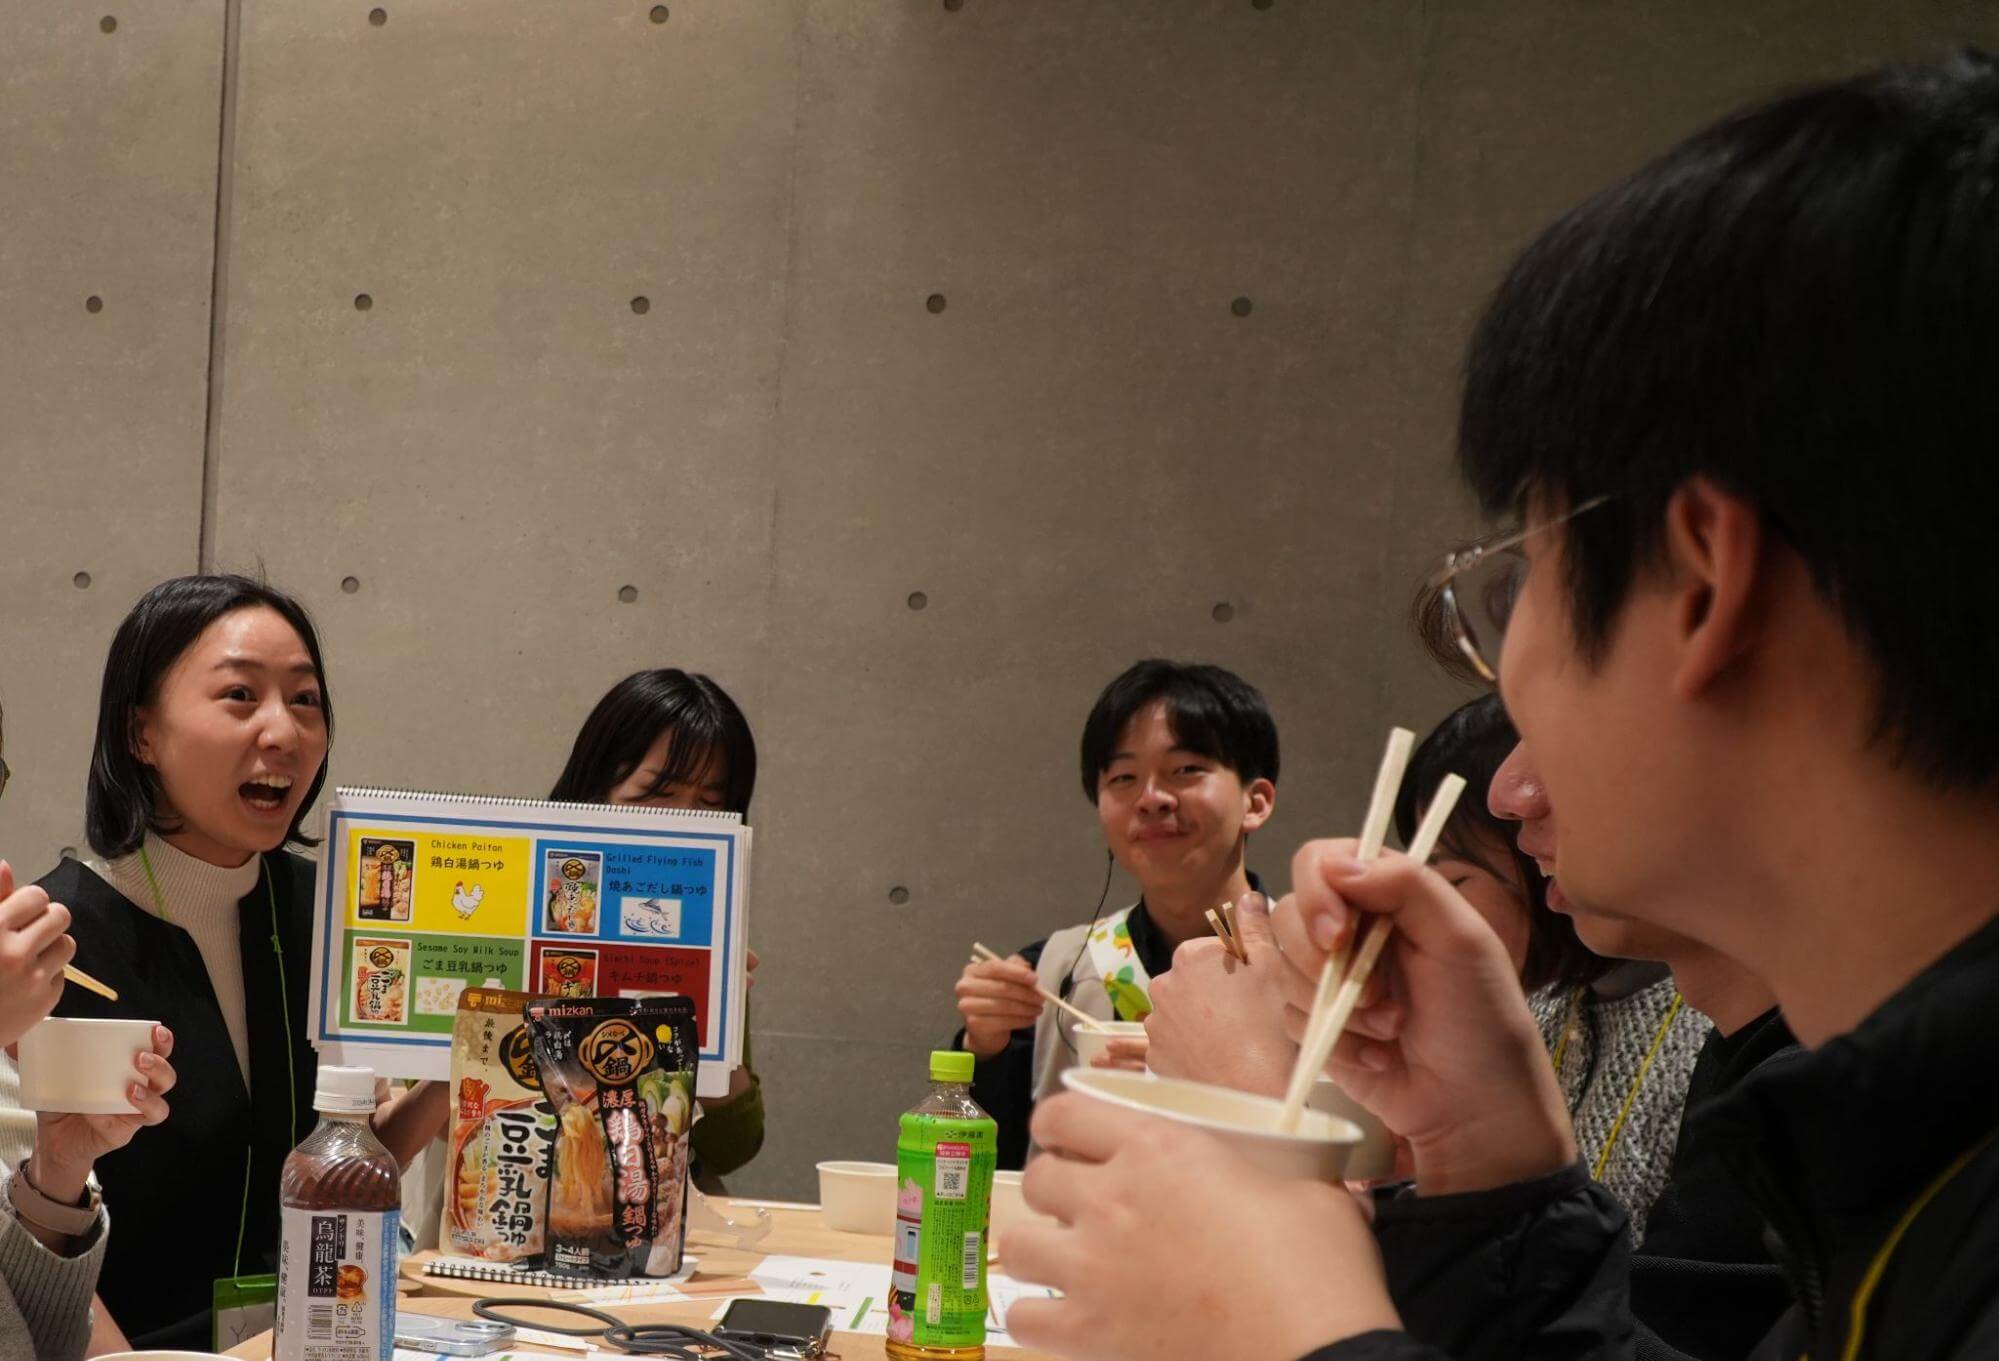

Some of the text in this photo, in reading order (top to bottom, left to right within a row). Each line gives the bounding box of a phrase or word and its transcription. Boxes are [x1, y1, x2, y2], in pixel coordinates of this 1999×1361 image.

[431, 839, 467, 850] Chicken
[431, 855, 504, 871] 鶏白湯鍋つゆ
[606, 853, 704, 867] Grilled Flying Fish
[606, 865, 631, 875] Dashi
[608, 880, 708, 896] 焼あごだし鍋つゆ
[417, 943, 519, 957] Sesame Soy Milk Soup
[422, 959, 508, 974] ごま豆乳鍋つゆ
[608, 970, 683, 985] キムチ鍋つゆ
[549, 1004, 593, 1017] mizkan
[603, 1089, 636, 1109] 濃厚
[313, 1220, 335, 1287] 烏龍茶
